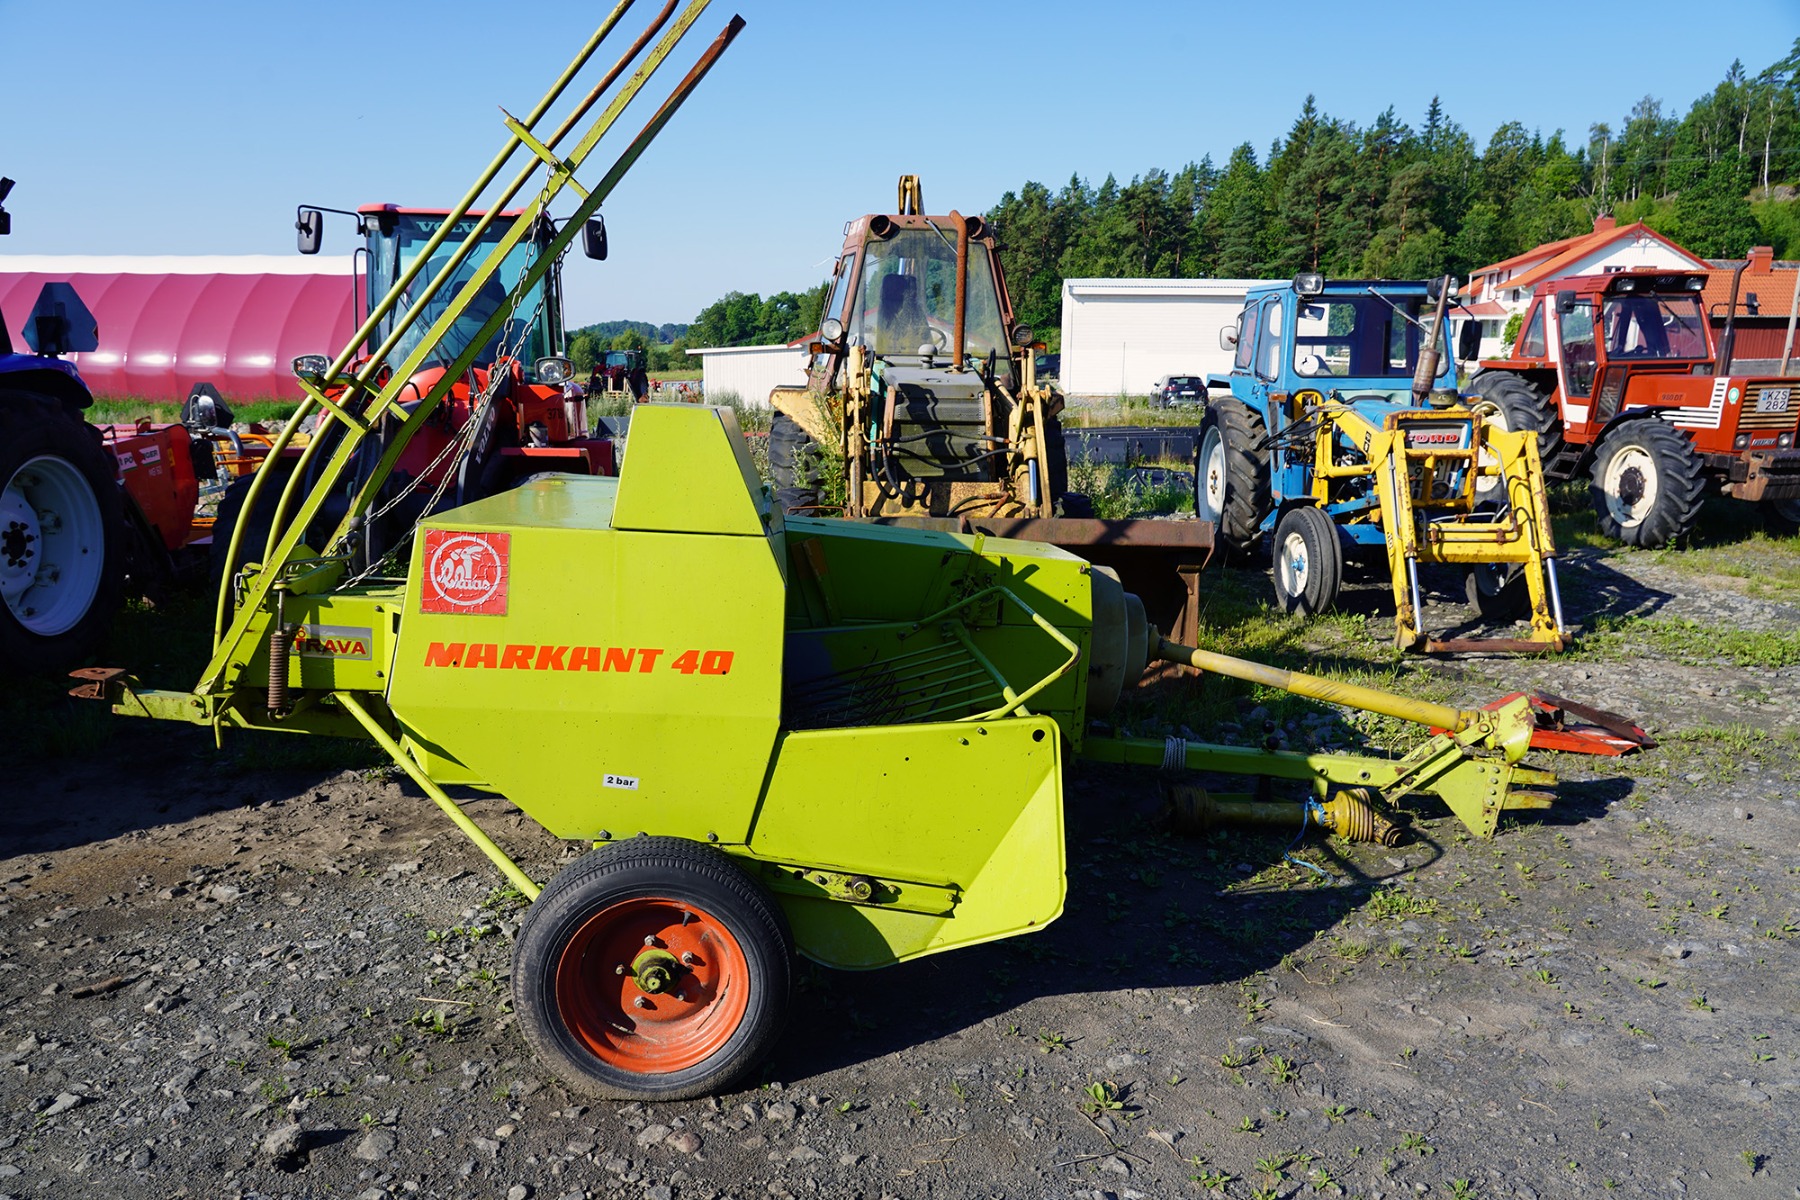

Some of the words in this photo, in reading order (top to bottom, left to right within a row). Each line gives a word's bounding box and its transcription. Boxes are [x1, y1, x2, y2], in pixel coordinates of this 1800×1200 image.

[1767, 390, 1788, 400] KZS
[1765, 401, 1786, 411] 282
[295, 637, 366, 655] TRAVA
[424, 642, 664, 673] MARKANT
[671, 650, 734, 675] 40
[606, 776, 615, 784] 2
[616, 776, 634, 787] bar
